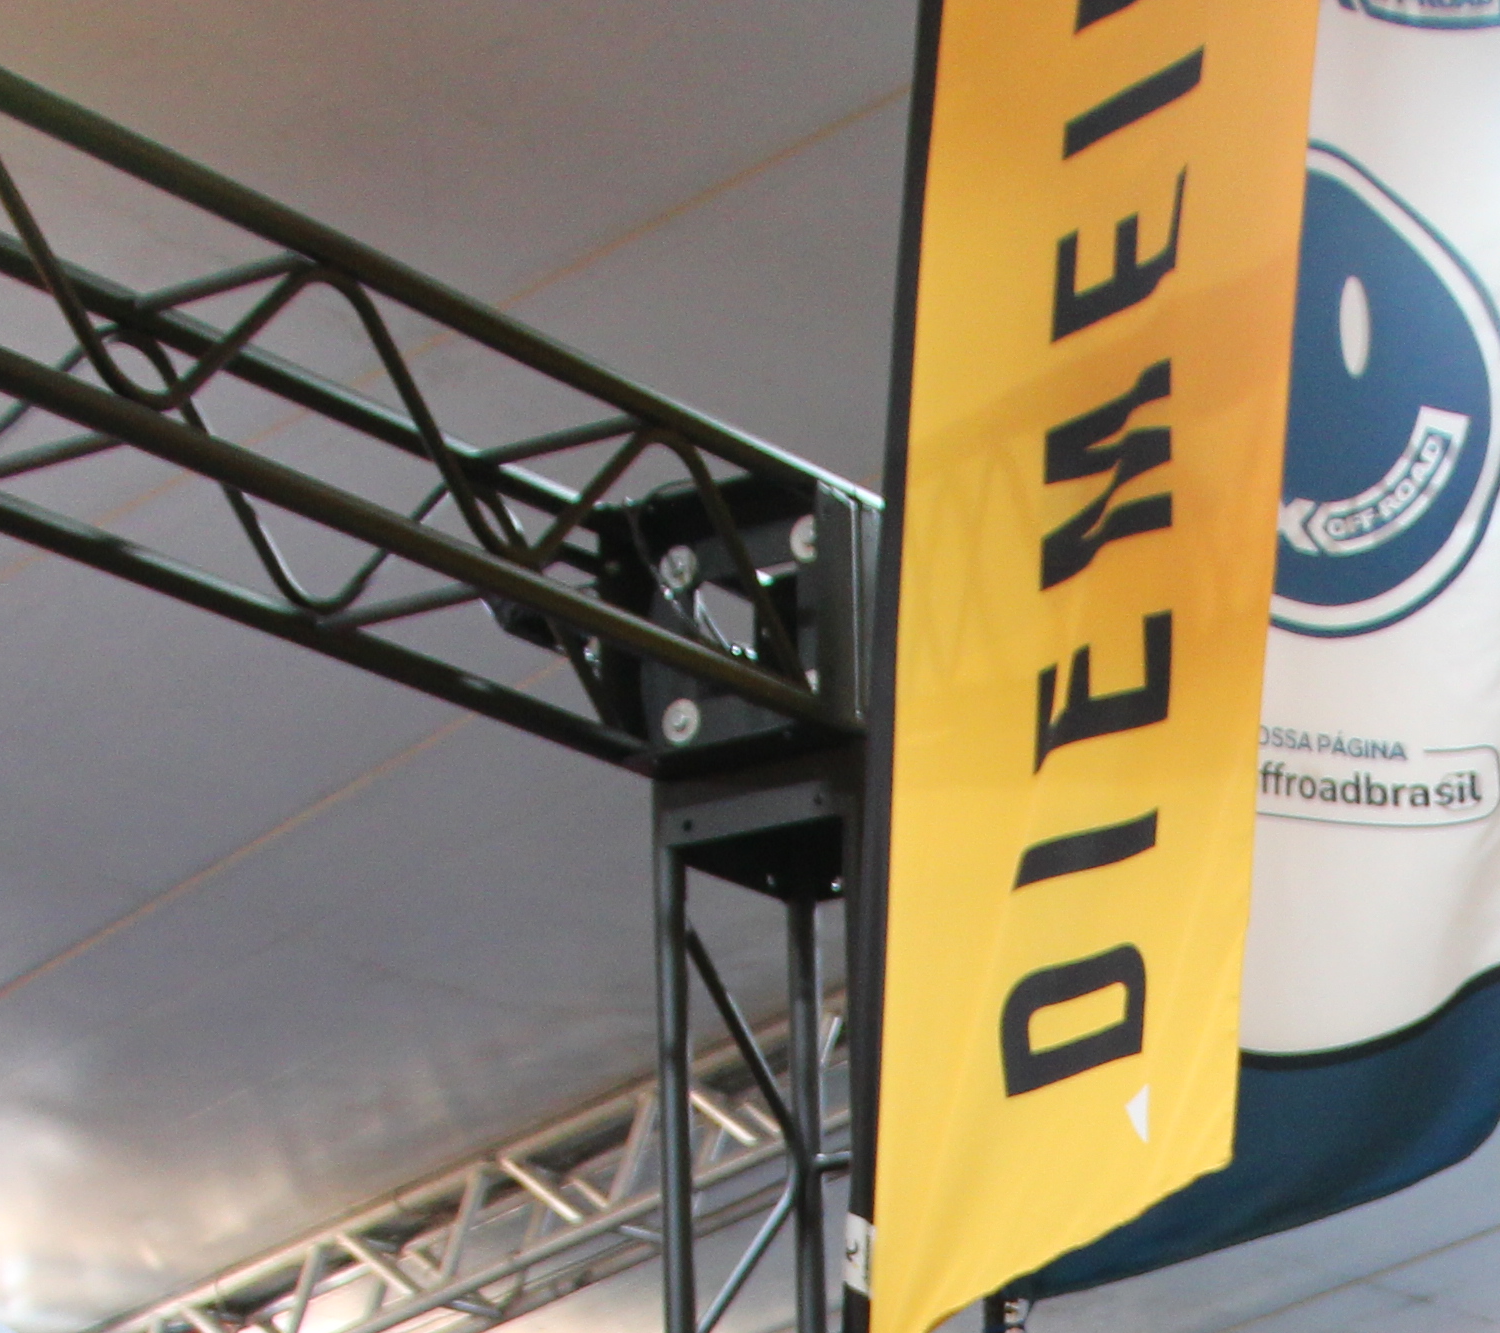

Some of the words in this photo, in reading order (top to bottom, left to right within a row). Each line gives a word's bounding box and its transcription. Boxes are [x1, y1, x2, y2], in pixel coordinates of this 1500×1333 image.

[1000, 0, 1204, 1097] DIEMEI
[1258, 725, 1312, 750] OSSA
[1317, 731, 1407, 761] PÁGINA
[1260, 760, 1481, 808] ffroadbrasil
